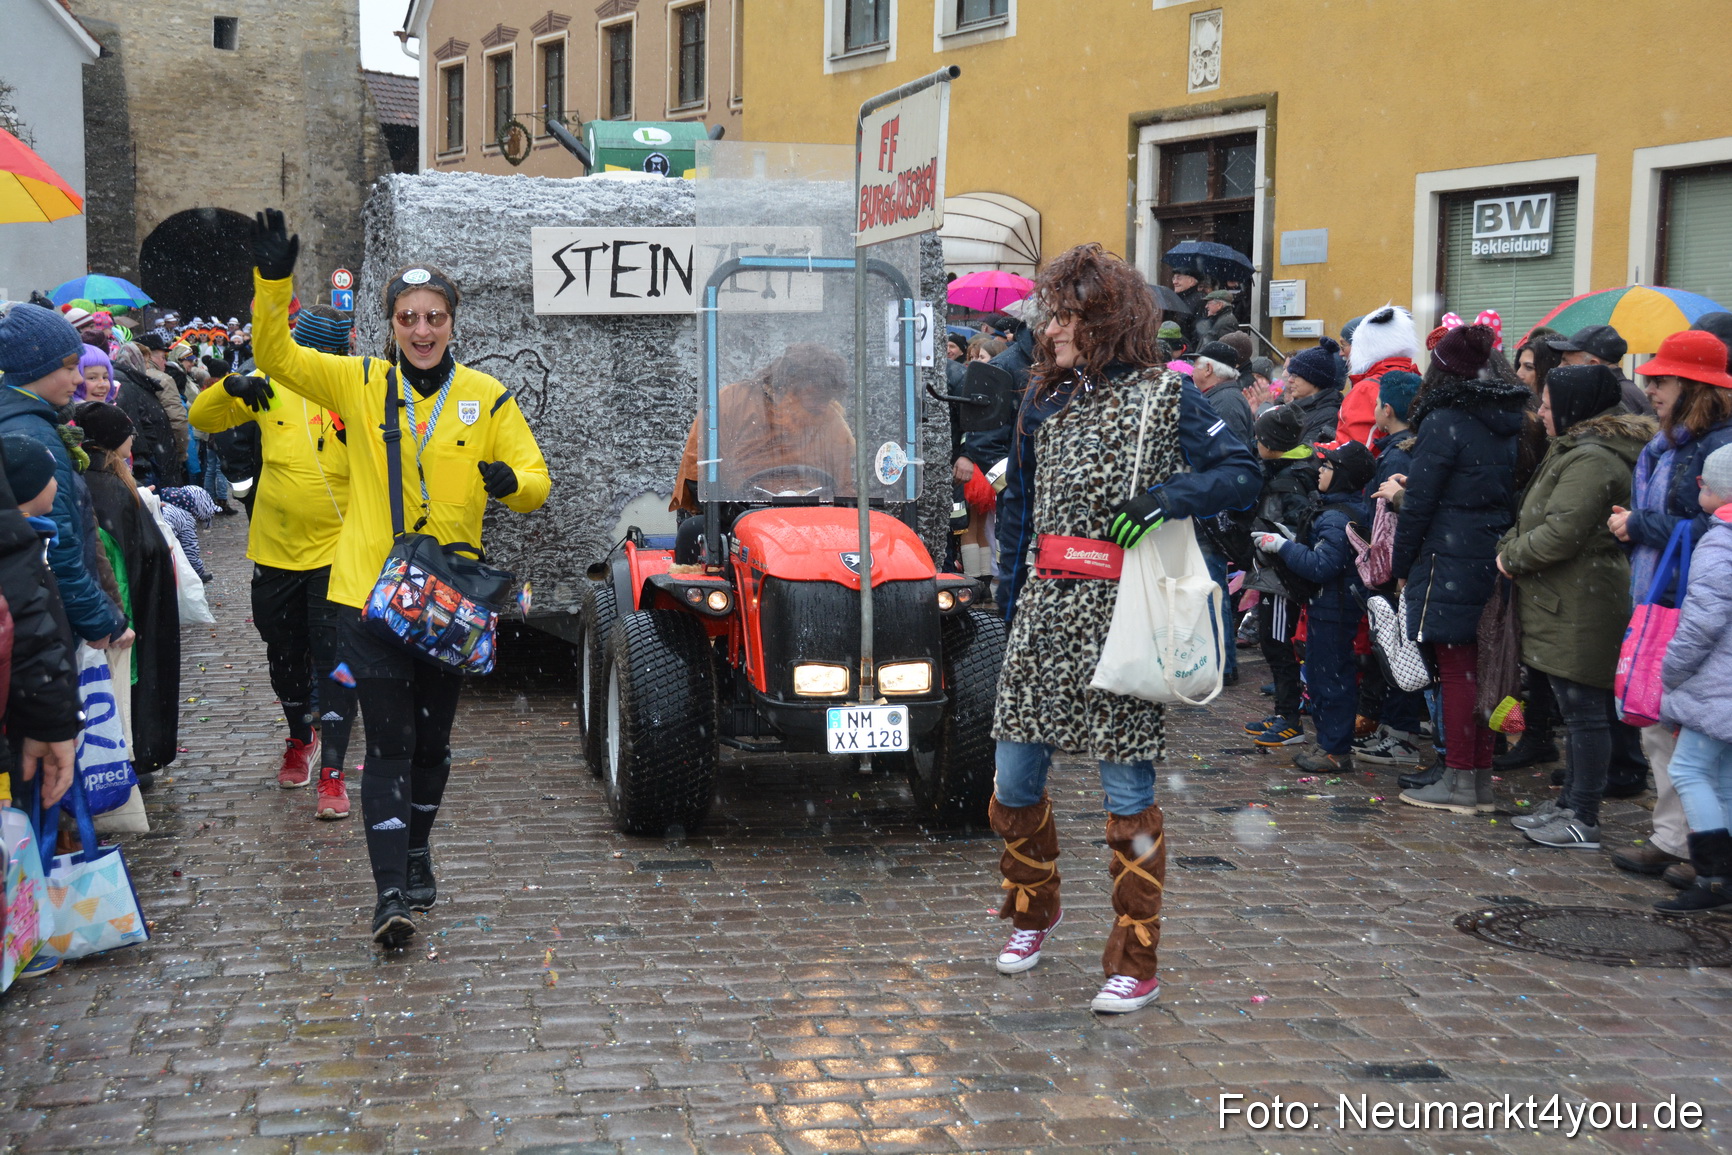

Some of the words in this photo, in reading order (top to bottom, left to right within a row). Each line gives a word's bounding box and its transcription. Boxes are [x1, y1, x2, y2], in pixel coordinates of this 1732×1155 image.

[878, 113, 900, 173] FF
[859, 157, 937, 232] BURGGRIESBACH
[1475, 198, 1548, 234] BW
[1471, 237, 1549, 255] Bekleidung
[337, 274, 342, 284] 3
[1064, 547, 1110, 561] Berentzen
[847, 711, 872, 729] NM
[835, 731, 859, 749] XX
[867, 729, 902, 748] 128
